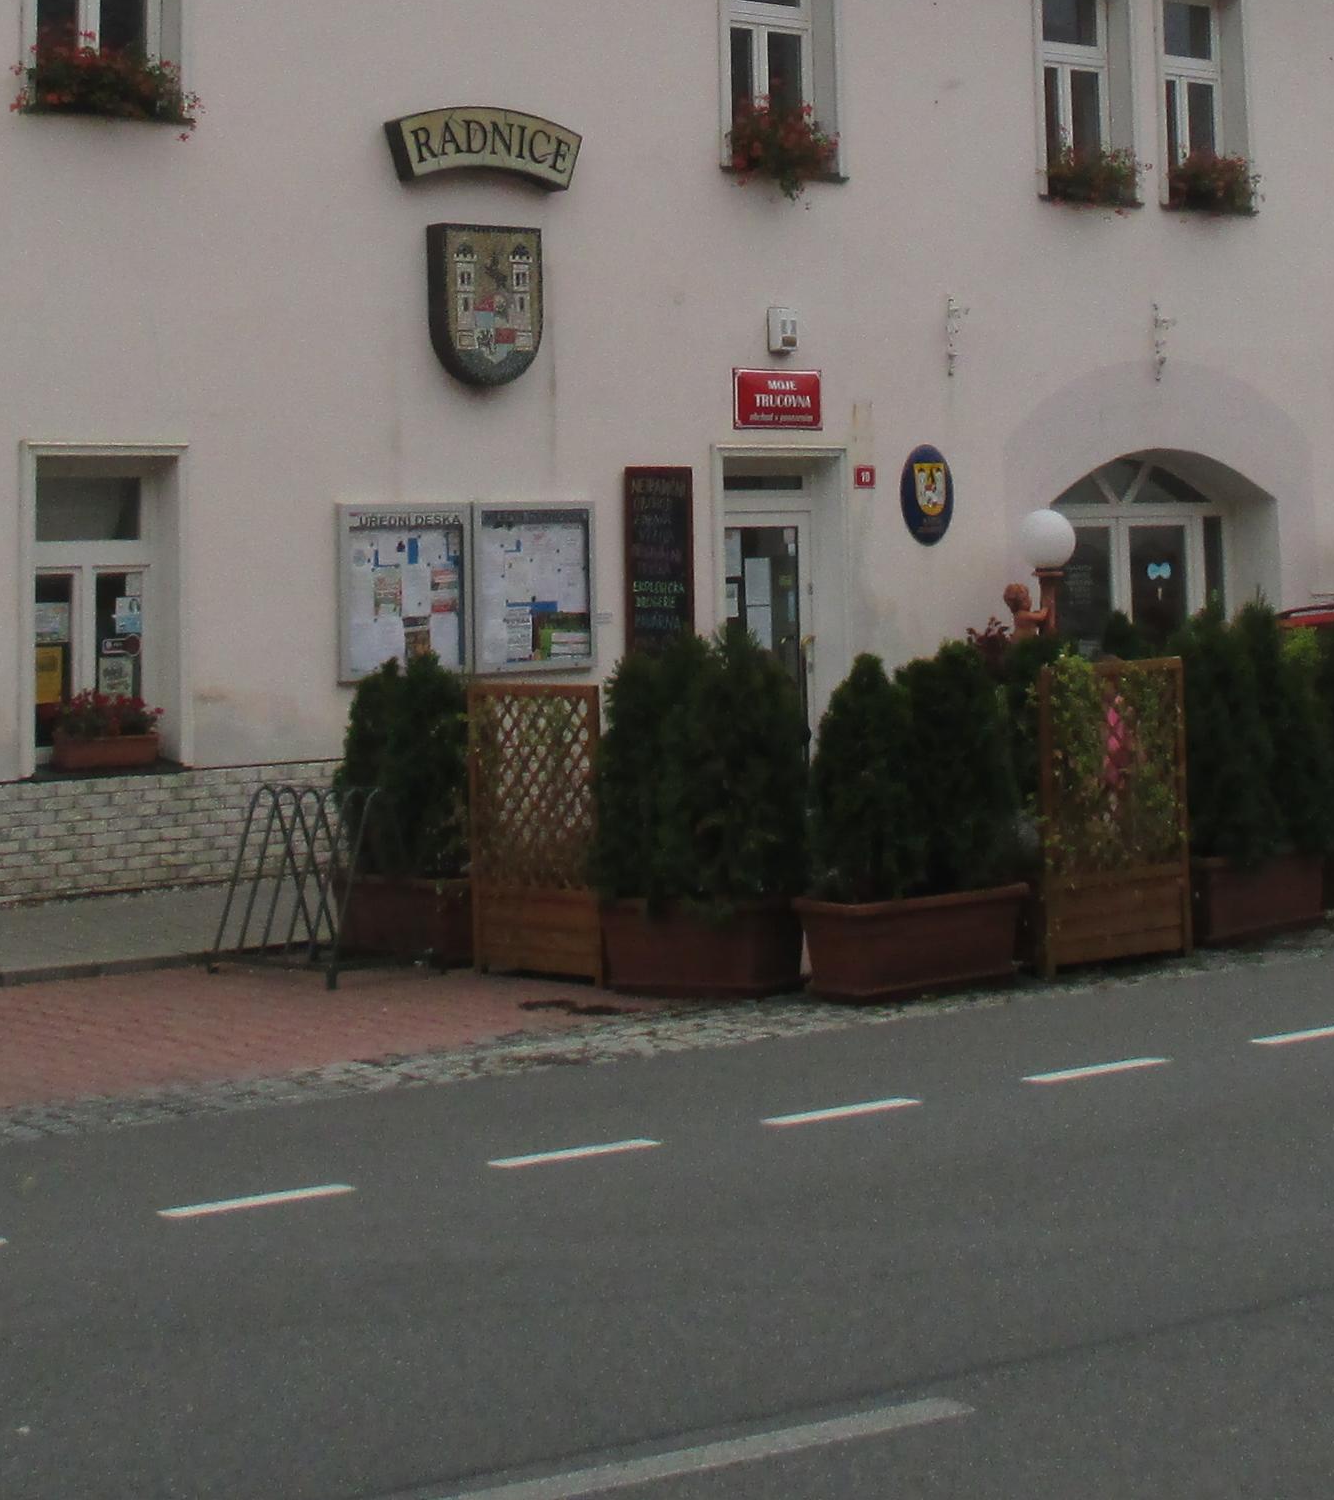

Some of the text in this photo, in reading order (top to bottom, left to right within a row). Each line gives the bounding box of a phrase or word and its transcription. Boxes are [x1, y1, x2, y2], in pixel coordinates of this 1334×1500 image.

[410, 119, 571, 174] RADNICE
[768, 380, 796, 390] MOJE
[755, 394, 811, 407] TRUCOVNA
[415, 513, 461, 526] DESKA
